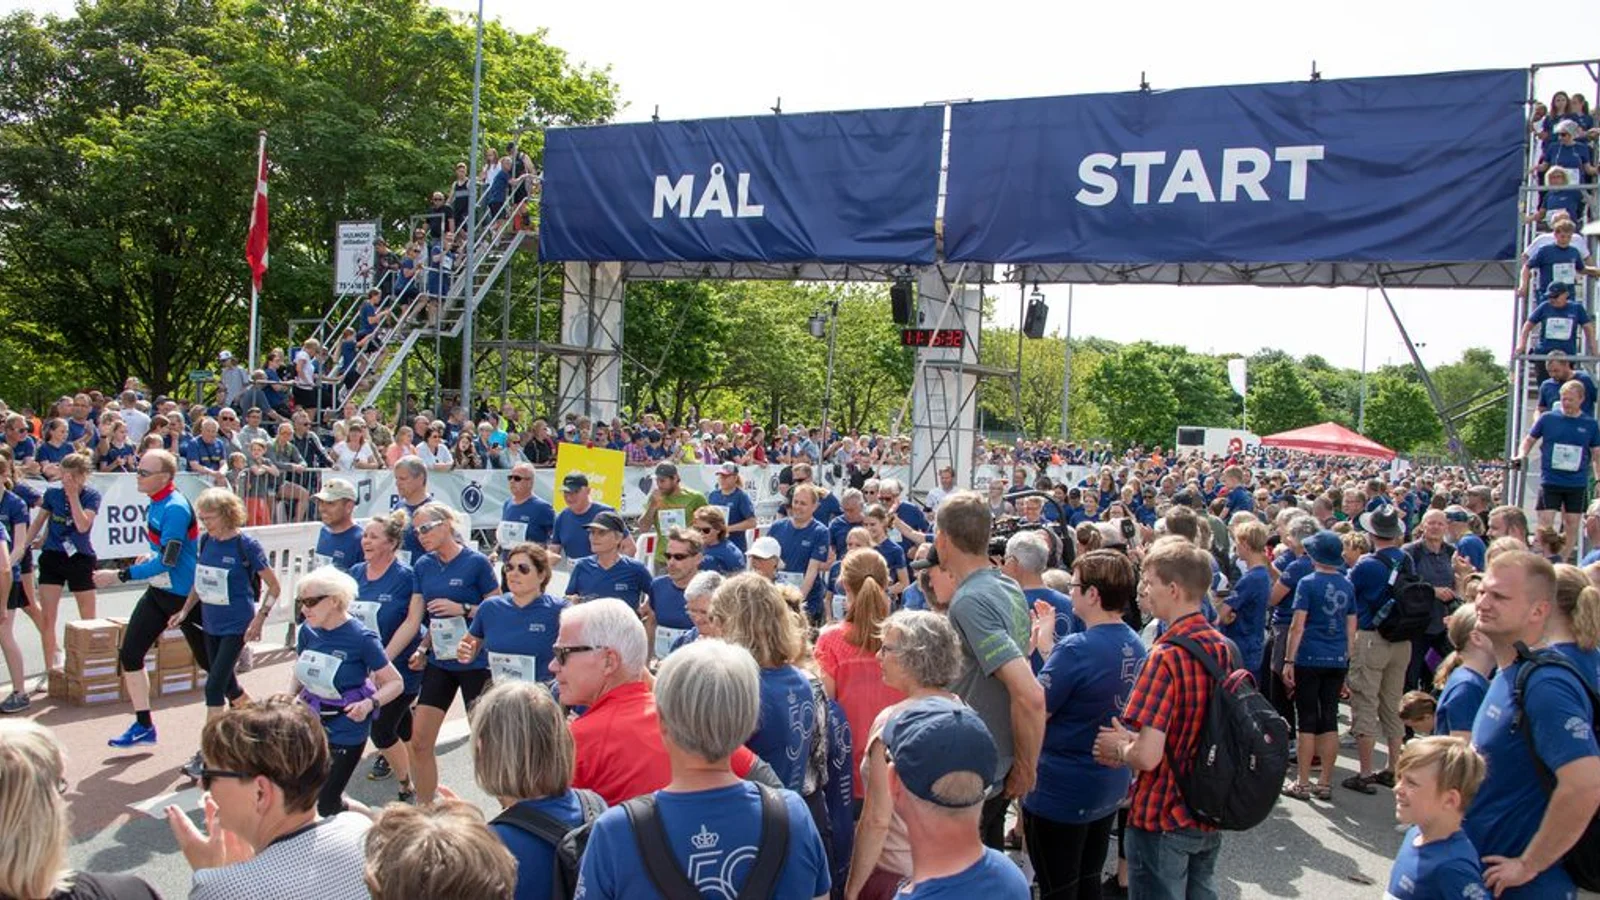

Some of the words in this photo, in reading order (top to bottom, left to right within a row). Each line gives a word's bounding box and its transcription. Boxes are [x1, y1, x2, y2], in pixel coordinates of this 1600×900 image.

[652, 162, 765, 219] MÅL
[1075, 145, 1325, 206] START
[107, 504, 151, 524] ROY
[108, 525, 151, 545] RUN
